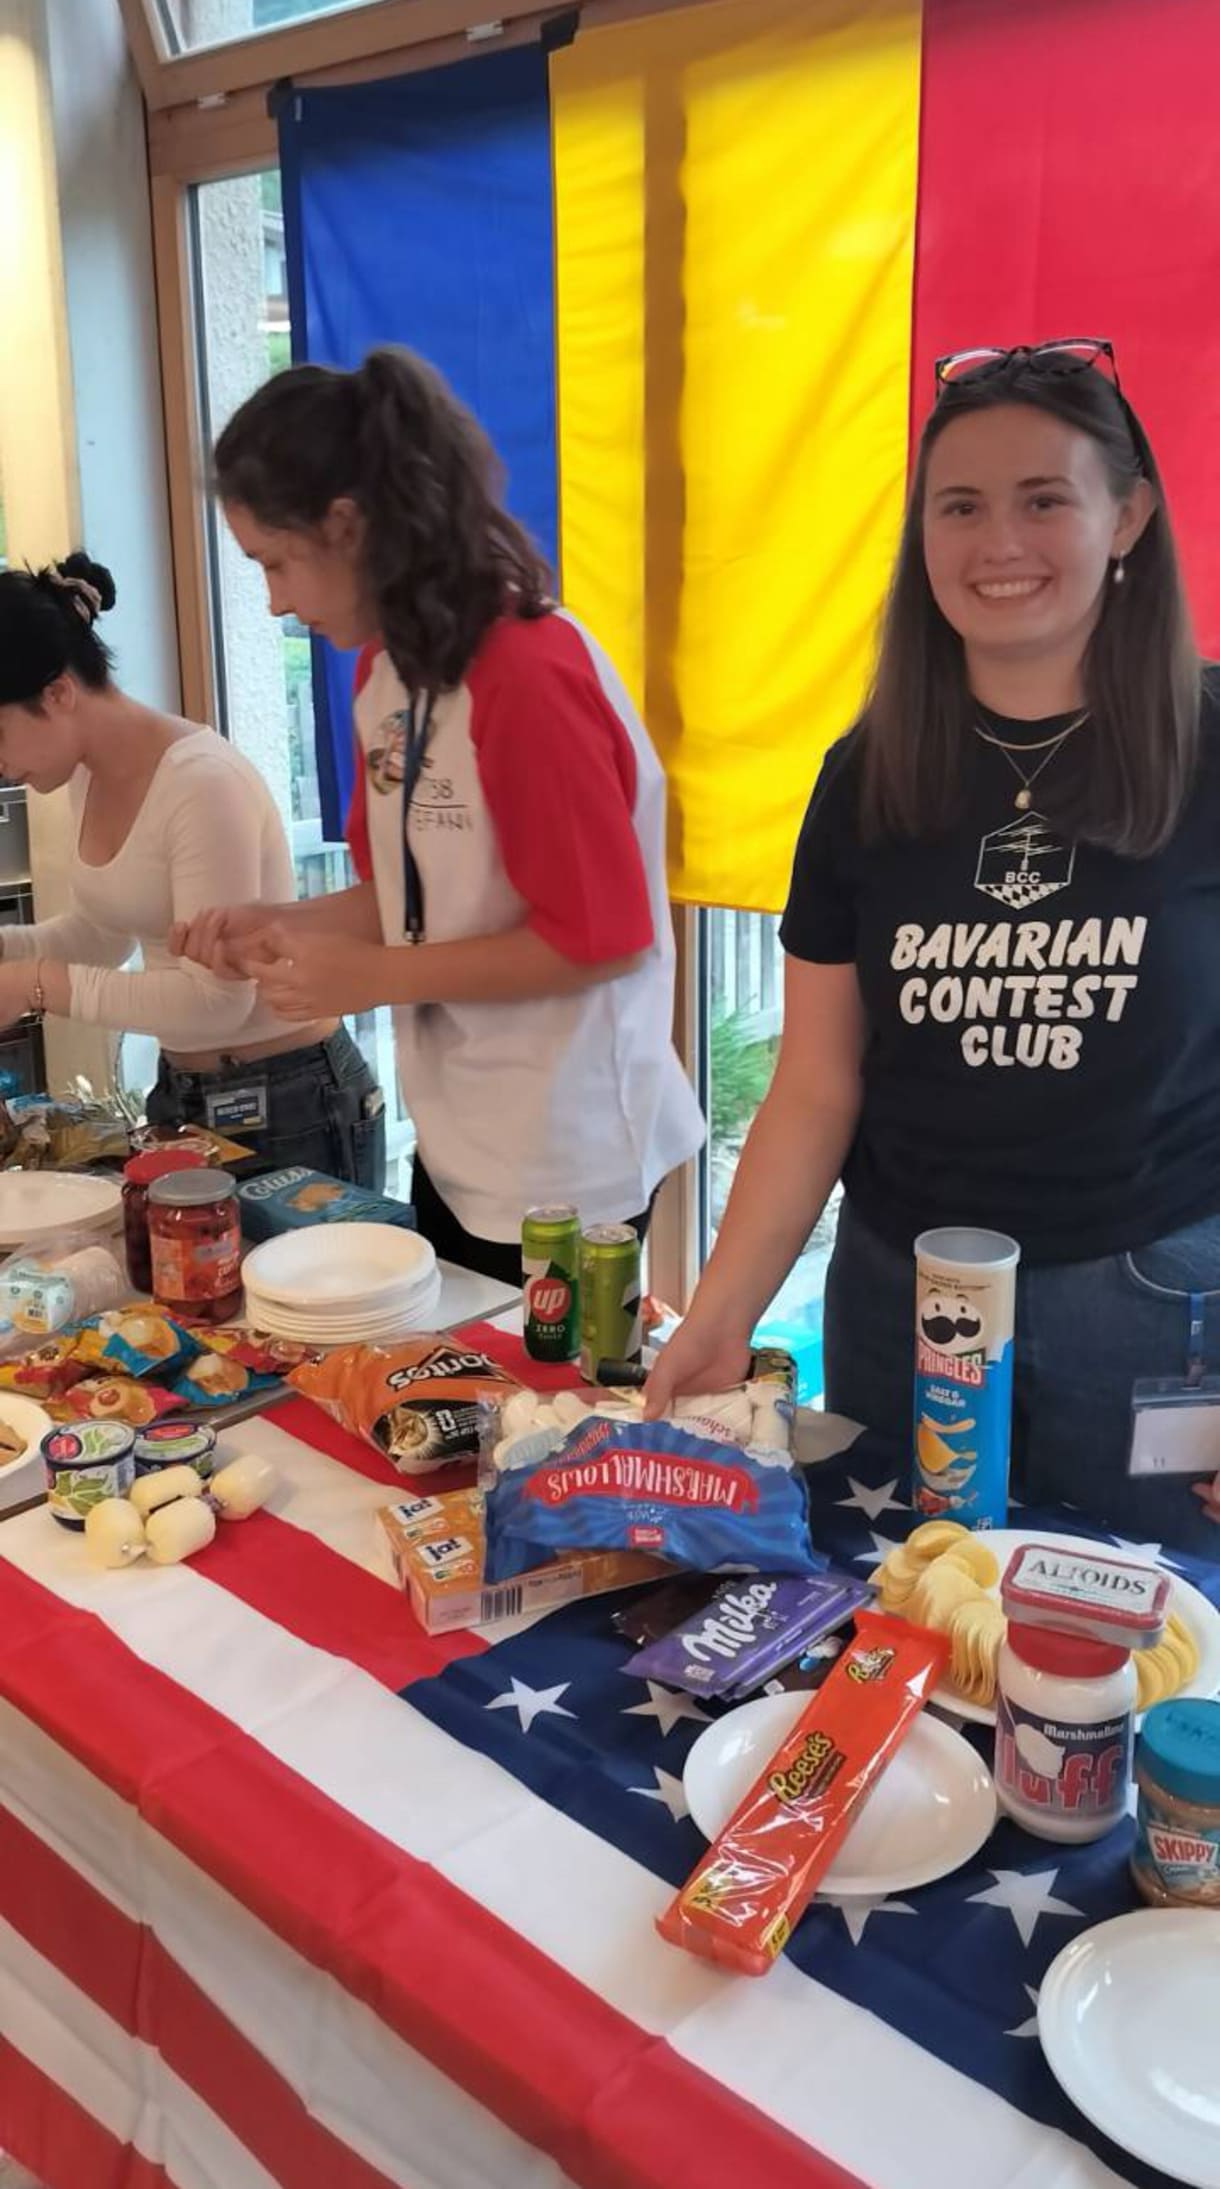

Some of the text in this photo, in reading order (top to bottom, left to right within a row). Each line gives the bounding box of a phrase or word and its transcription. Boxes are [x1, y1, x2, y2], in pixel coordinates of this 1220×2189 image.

[1005, 871, 1041, 884] BCC
[890, 916, 1149, 971] BAVARIAN
[899, 974, 1139, 1024] CONTEST
[960, 1023, 1083, 1070] CLUB
[535, 1324, 566, 1334] ZERO
[917, 1346, 983, 1386] PRINGLES
[398, 1499, 433, 1519] ja!
[425, 1538, 462, 1562] ja!
[682, 1582, 777, 1662] Milka
[768, 1732, 833, 1802] Reese's
[1154, 1834, 1218, 1863] SKIPPY
